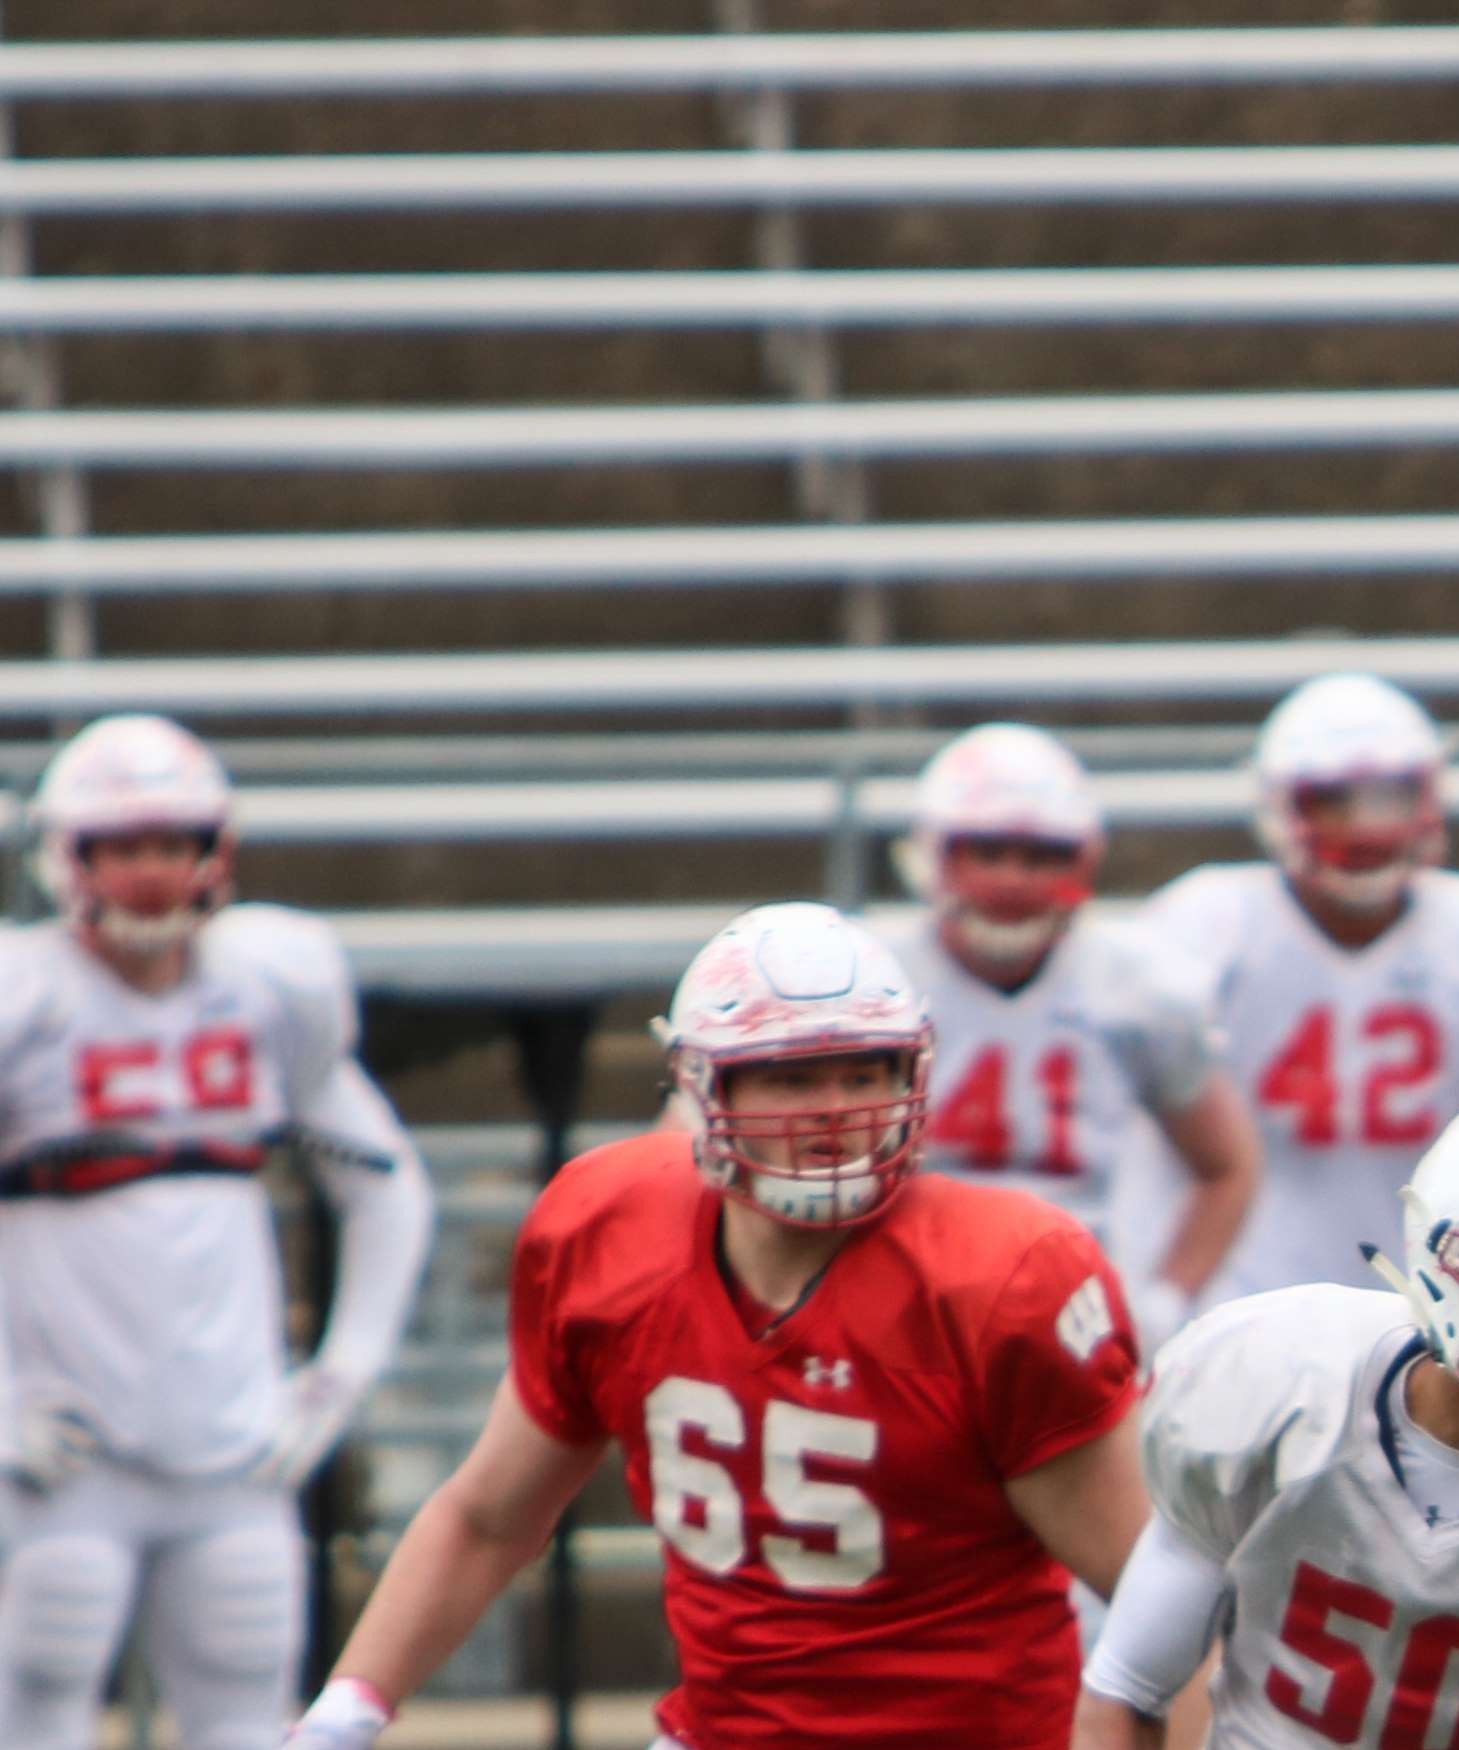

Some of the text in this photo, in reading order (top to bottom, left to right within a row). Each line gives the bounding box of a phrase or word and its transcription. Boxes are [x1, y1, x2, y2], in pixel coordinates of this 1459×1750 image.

[924, 1045, 1085, 1175] 41
[1257, 1007, 1441, 1144] 42
[645, 1377, 883, 1589] 65
